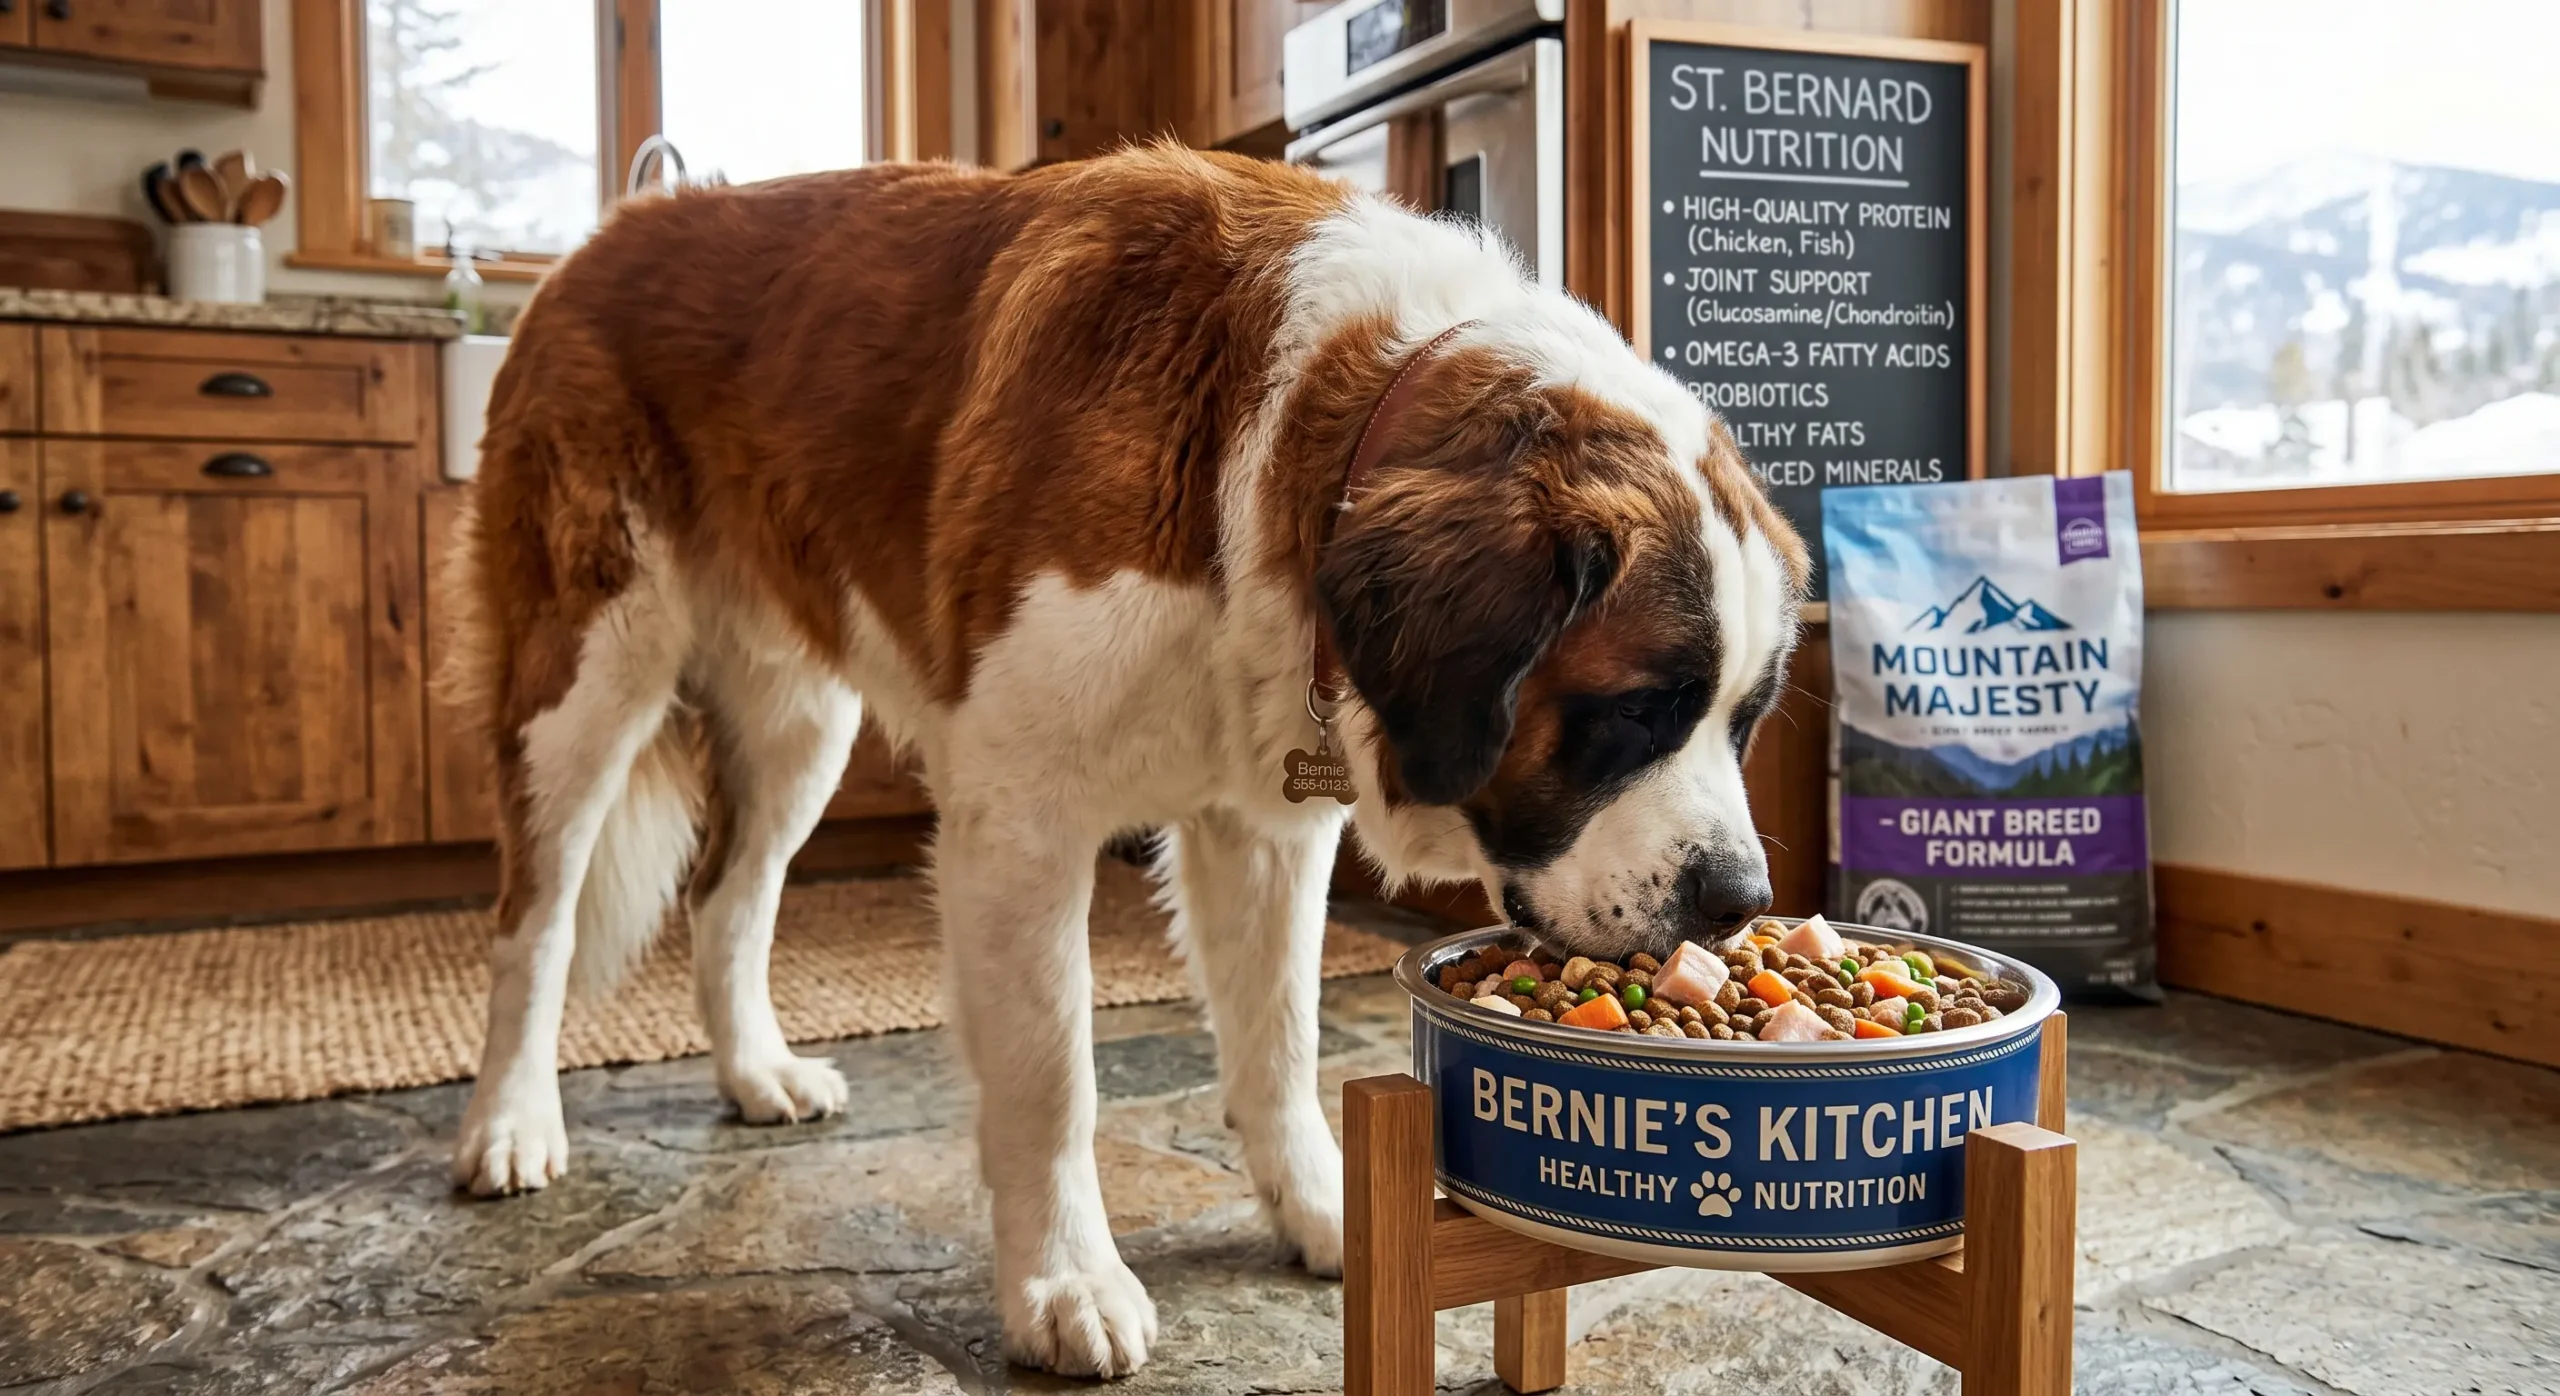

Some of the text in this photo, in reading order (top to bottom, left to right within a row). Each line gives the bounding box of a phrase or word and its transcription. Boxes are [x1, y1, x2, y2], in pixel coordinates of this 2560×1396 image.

[1670, 64, 1933, 124] ST. BERNARD
[1701, 126, 1903, 172] NUTRITION
[1683, 196, 1951, 229] HIGH-QUALITY PROTEIN
[1688, 224, 1855, 259] (Chicken, Fish)
[1684, 267, 1872, 296] JOINT SUPPORT
[1687, 296, 1955, 330] (Glucosamine/Chondroitin)
[1685, 340, 1951, 369] OMEGA-3 FATTY ACIDS
[1737, 421, 1866, 447] LTHY FATS
[1825, 458, 1944, 485] MINERALS
[1872, 637, 2109, 677] MOUNTAIN
[1885, 680, 2100, 717] MAJESTY
[1293, 779, 1350, 792] 555-0123
[1298, 762, 1345, 777] Bernie
[1900, 808, 1996, 836] GIANT
[2004, 807, 2102, 836] BREED
[1926, 840, 2076, 867] FORMULA
[1472, 1067, 1993, 1162] BERNIE'S KITCHEN
[1539, 1156, 1927, 1211] HEALTHY NUTRITION
